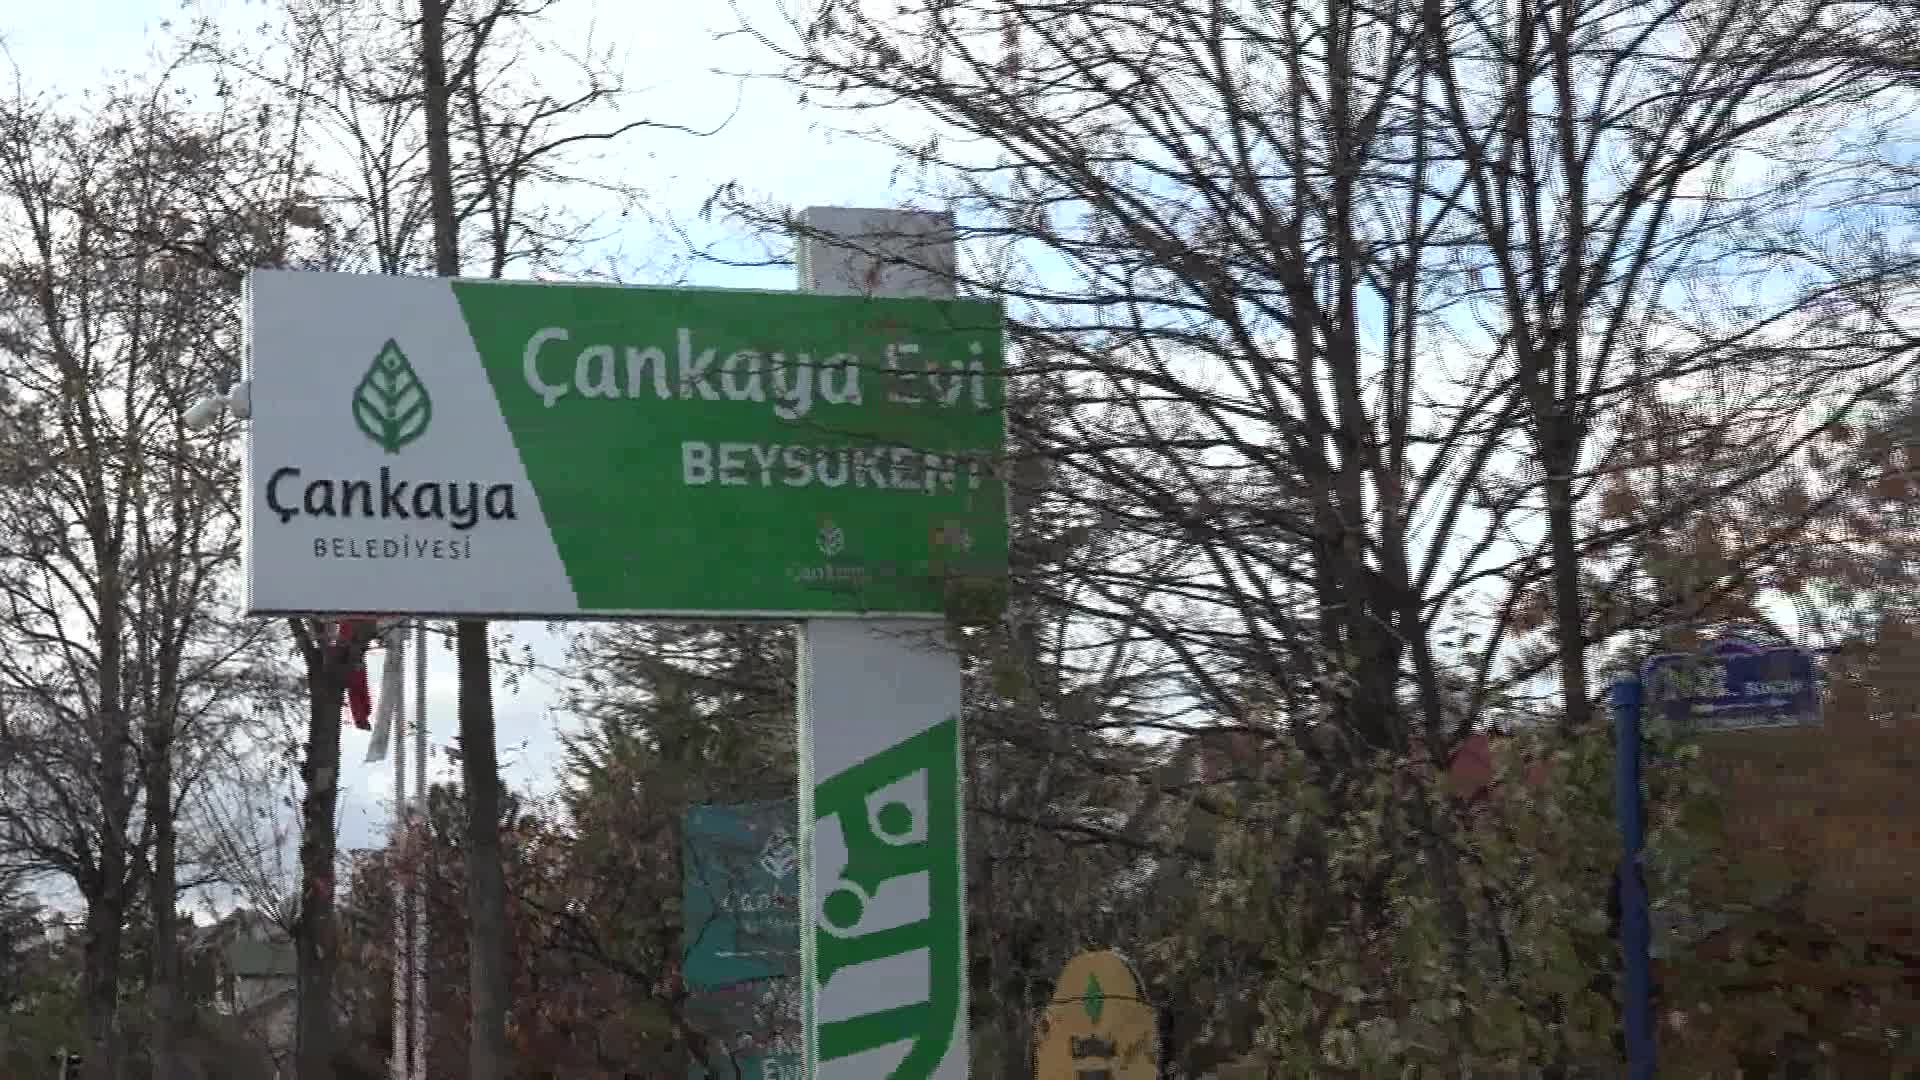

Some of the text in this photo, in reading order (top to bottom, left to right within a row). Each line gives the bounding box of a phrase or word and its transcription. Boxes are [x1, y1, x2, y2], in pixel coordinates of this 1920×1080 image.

[523, 327, 863, 420] Çankaya
[266, 466, 518, 530] Çankaya
[313, 535, 472, 559] BELEDİYESİ
